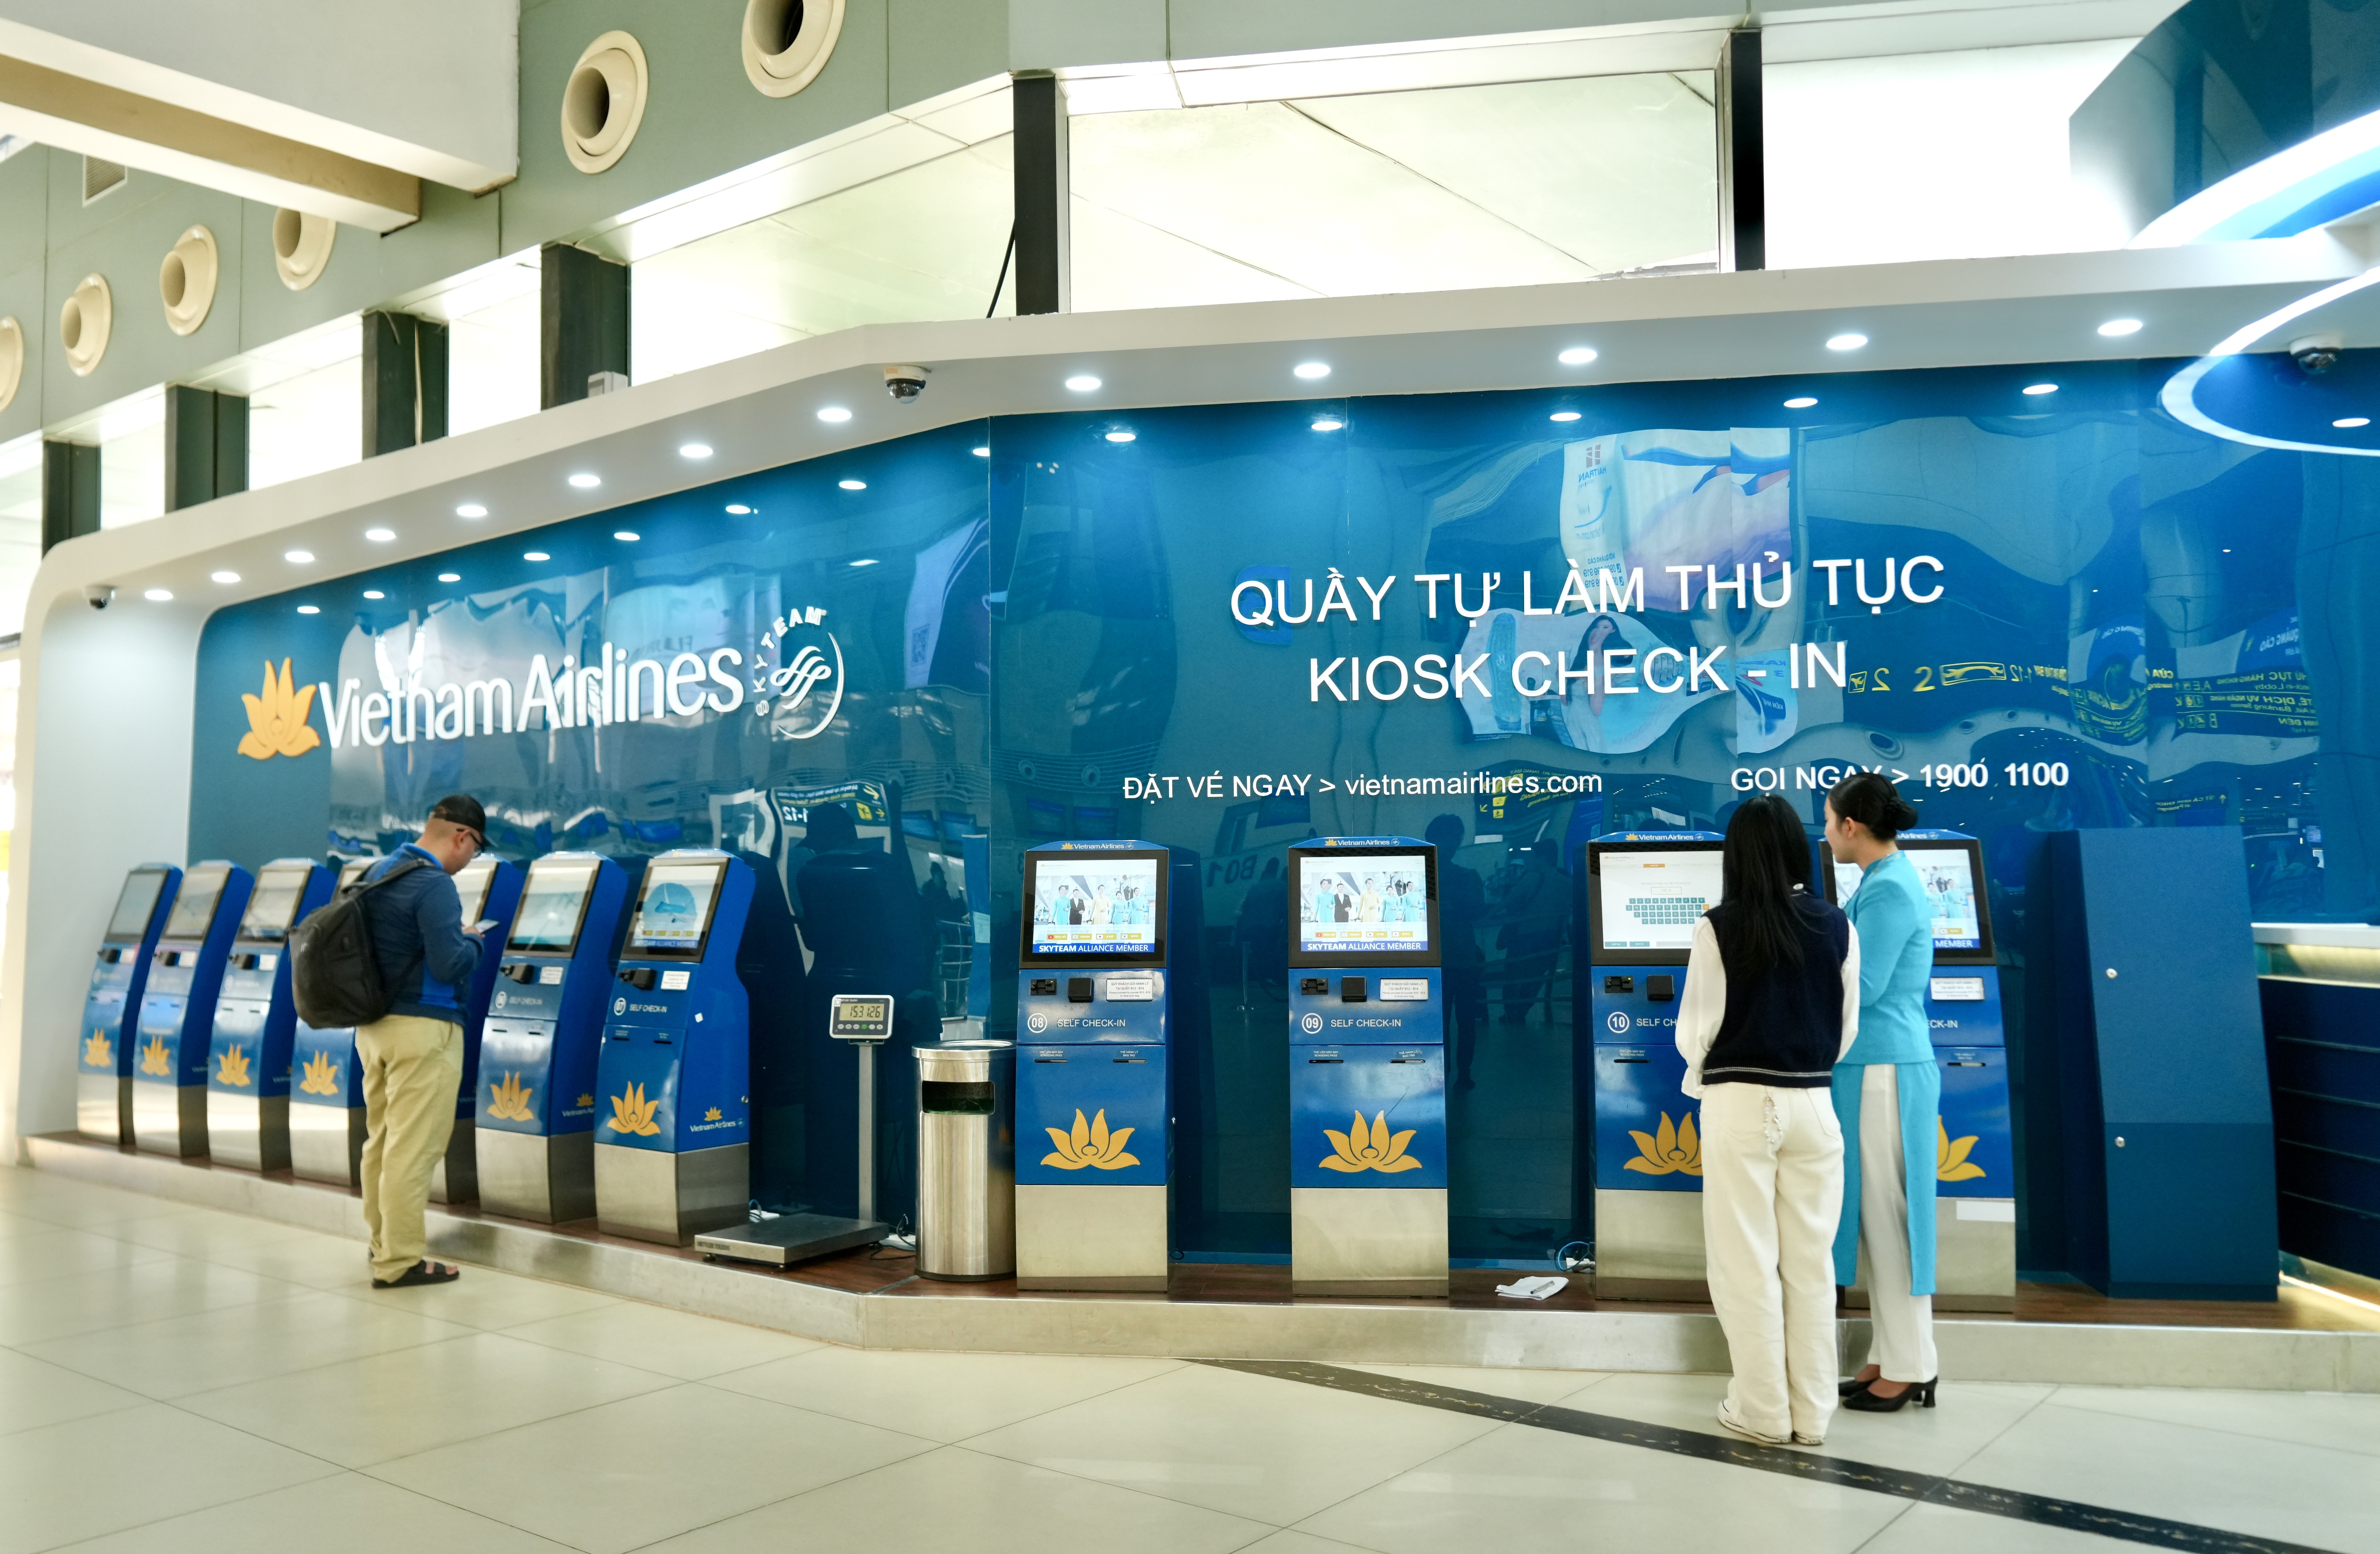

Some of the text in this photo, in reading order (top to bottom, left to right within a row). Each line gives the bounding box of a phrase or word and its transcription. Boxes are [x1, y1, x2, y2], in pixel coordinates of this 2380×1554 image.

[1231, 551, 1944, 628] QUẦY TỰ LÀM THỦ TỤC
[1310, 653, 1493, 702] KIOSK
[1511, 645, 1730, 697] CHECK
[1790, 641, 1846, 689] IN
[319, 641, 744, 748] Vietnam Airlines
[1920, 764, 1988, 787] 1900
[2004, 762, 2069, 786] 1100
[1122, 773, 1179, 805] ĐẶT
[1186, 770, 1223, 798] VÉ
[1233, 774, 1312, 797] NGAY
[1319, 779, 1336, 793] >
[1345, 772, 1601, 796] vietnamairlines.com
[1935, 939, 1973, 948] MEMBER
[1031, 1017, 1043, 1028] 08
[1057, 1019, 1126, 1027] SELF CHECK-IN
[1306, 1017, 1319, 1029] 09
[1330, 1019, 1401, 1027] SELF CHECK-IN
[1612, 1016, 1625, 1028] 10
[1636, 1018, 1661, 1027] SELF
[690, 1120, 736, 1133] Vietnam Airlines
